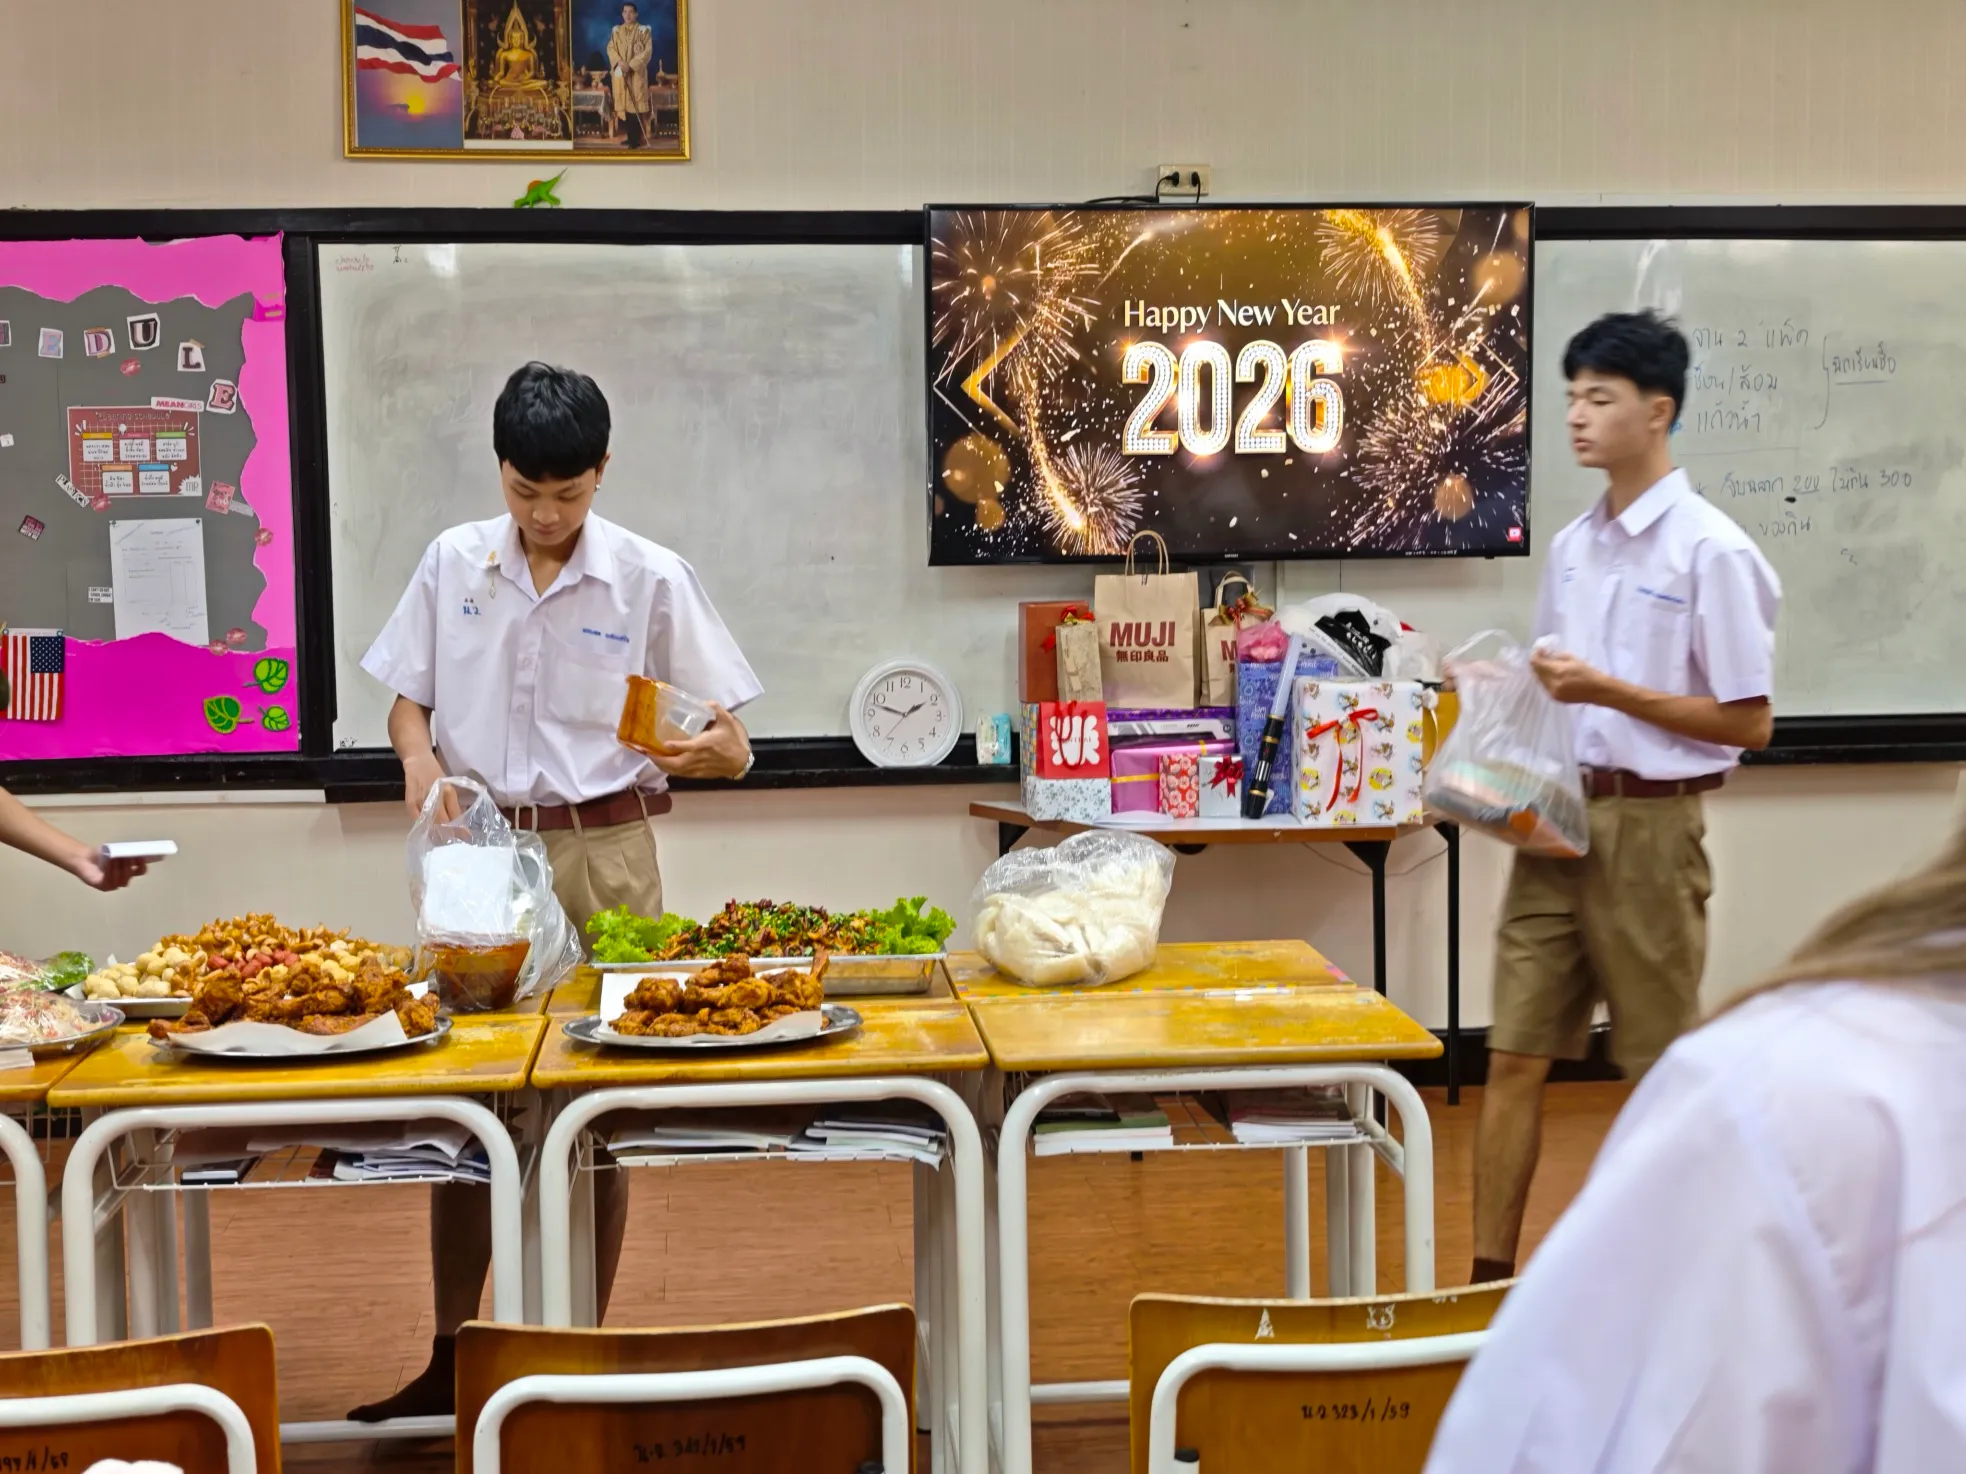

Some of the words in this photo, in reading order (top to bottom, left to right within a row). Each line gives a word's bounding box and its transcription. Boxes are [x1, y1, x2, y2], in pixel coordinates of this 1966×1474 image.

[1124, 299, 1212, 334] Happy
[1217, 299, 1277, 327] New
[1281, 298, 1341, 326] Year
[1737, 330, 1749, 348] 2
[1122, 339, 1344, 456] 2026
[1109, 621, 1176, 647] MUJI
[1115, 649, 1169, 663] 無印良品
[886, 681, 894, 693] 11
[899, 676, 912, 690] 12
[919, 681, 924, 693] 1
[873, 692, 886, 705] 10
[929, 694, 939, 706] 2
[867, 708, 876, 721] 9
[935, 710, 943, 722] 3
[872, 725, 881, 738] 8
[928, 726, 936, 738] 4
[886, 737, 895, 750] 7
[900, 741, 909, 754] 6
[918, 738, 925, 750] 5
